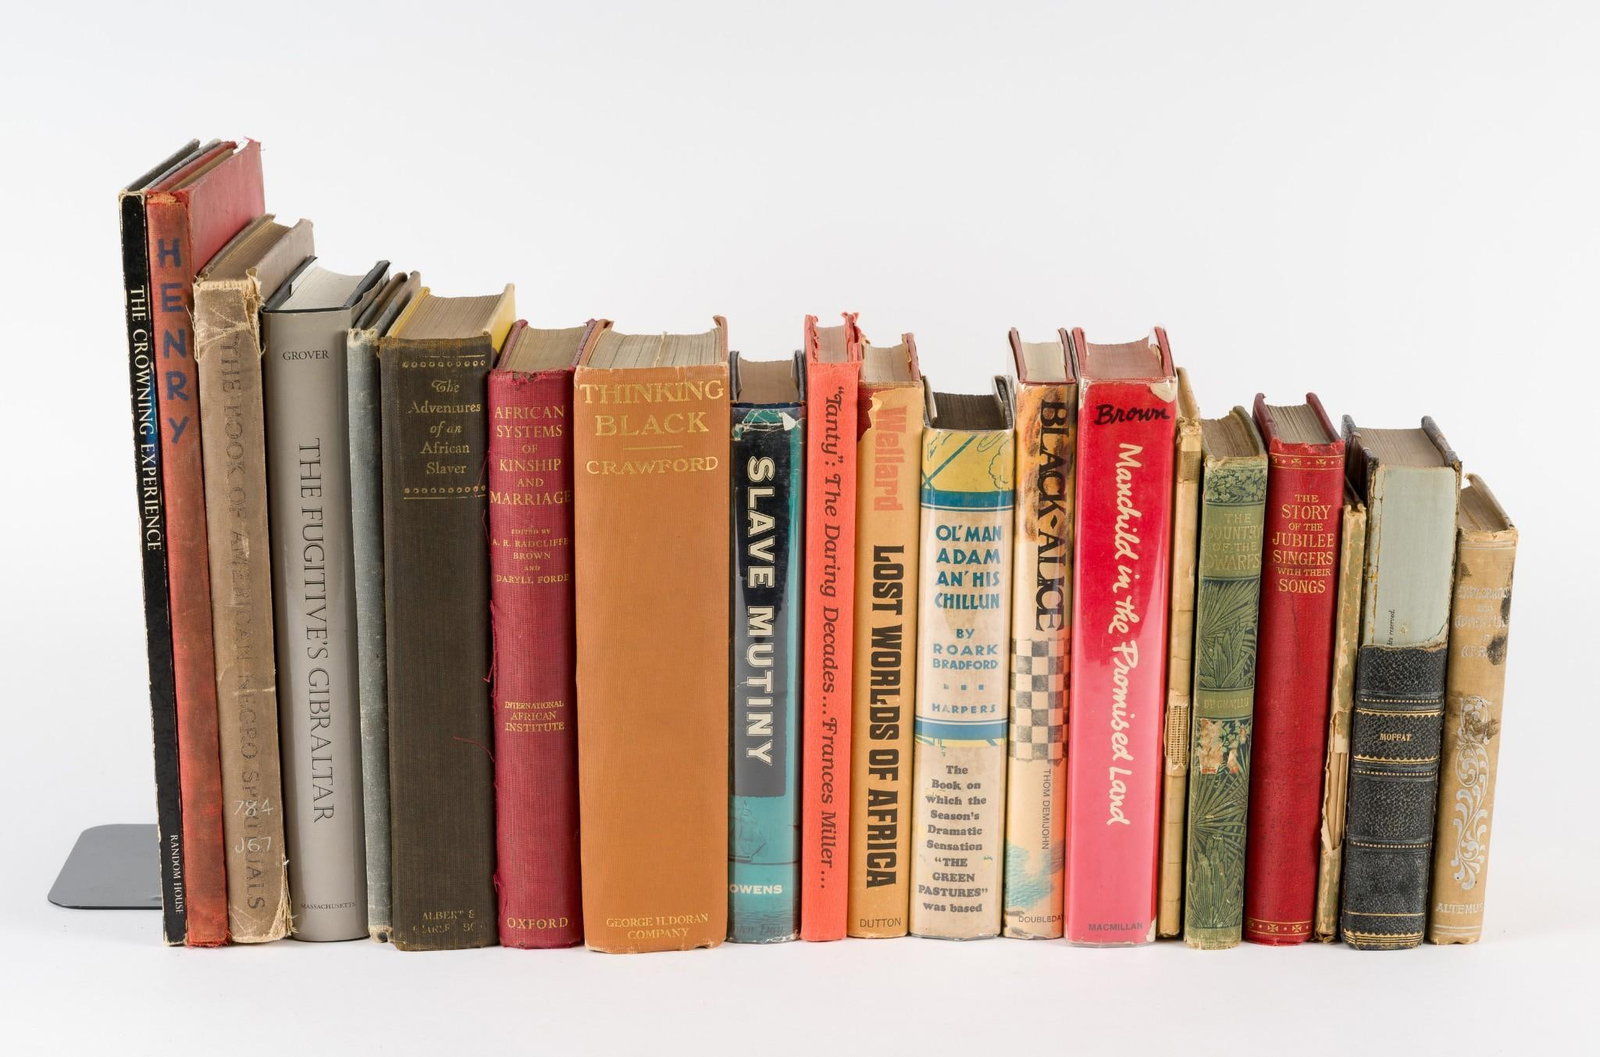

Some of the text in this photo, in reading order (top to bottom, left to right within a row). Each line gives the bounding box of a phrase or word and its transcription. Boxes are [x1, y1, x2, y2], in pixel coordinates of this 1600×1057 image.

[158, 237, 190, 444] HENRY
[283, 350, 329, 362] GROVER
[431, 379, 460, 393] The
[578, 380, 725, 405] THINKING
[408, 401, 481, 415] Adventures
[494, 405, 565, 419] AFRICAN
[1094, 403, 1170, 426] Brown
[130, 285, 162, 551] THE CROWNING EXPERIENCE
[594, 411, 710, 438] BLACK
[429, 421, 463, 437] of an
[496, 424, 563, 438] SYSTEMS
[420, 442, 471, 455] African
[521, 443, 539, 454] OF
[874, 405, 908, 512] Wellard
[426, 463, 468, 476] Slaver
[499, 458, 562, 473] KINSHIP
[586, 456, 719, 476] CRAWFORD
[515, 477, 545, 488] AND
[490, 489, 571, 505] MARRIAGE
[824, 473, 842, 517] The
[1295, 494, 1319, 503] THE
[1223, 513, 1252, 524] THE
[1281, 504, 1331, 520] STORY
[1288, 522, 1324, 532] OF THE
[514, 537, 569, 548] RADCLIFFE
[1234, 541, 1259, 552] THE
[1272, 532, 1335, 548] JUBILEE
[512, 552, 552, 560] BROWN
[820, 524, 841, 598] Daring
[936, 548, 1001, 565] ADAM
[1272, 550, 1334, 566] SINGERS
[1276, 567, 1332, 576] WITH THEIR
[537, 573, 569, 584] FORDE
[972, 572, 1000, 587] HIS
[1278, 579, 1326, 594] SONGS
[934, 592, 1000, 610] CHILLUN
[746, 455, 776, 767] SLAVE MUTINY
[299, 438, 336, 824] THE FUGITIVE'S GIBRALTAR
[956, 627, 975, 639] BY
[1106, 442, 1144, 825] Manchild in the Promised Land
[933, 643, 998, 656] ROARK
[932, 657, 998, 670] BRADFORD
[504, 700, 564, 709] INTERNATIONAL
[932, 703, 997, 714] HARPERS
[509, 710, 557, 721] AFRICAN
[866, 544, 905, 889] LOST WORLDS OF AFRICA
[504, 721, 565, 732] INSTITUTE
[1379, 733, 1413, 742] MOFFAT
[821, 717, 838, 805] Frances
[946, 765, 969, 775] The
[931, 779, 981, 790] Book on
[925, 794, 987, 807] which the
[233, 799, 274, 817] 784
[1041, 769, 1051, 850] THOM DEMIJOHN
[930, 810, 980, 821] Season's
[927, 825, 983, 837] Dramatic
[234, 836, 273, 854] J67
[926, 840, 983, 851] Sensation
[170, 834, 183, 914] RANDOM HOUSE
[932, 872, 975, 882] GREEN
[729, 884, 783, 895] OWENS
[923, 902, 983, 913] was based
[506, 916, 569, 930] OXFORD
[606, 917, 653, 928] GEORGE
[859, 917, 902, 929] DUTTON
[1088, 922, 1143, 932] MACMILLAN
[627, 927, 689, 940] COMPANY
